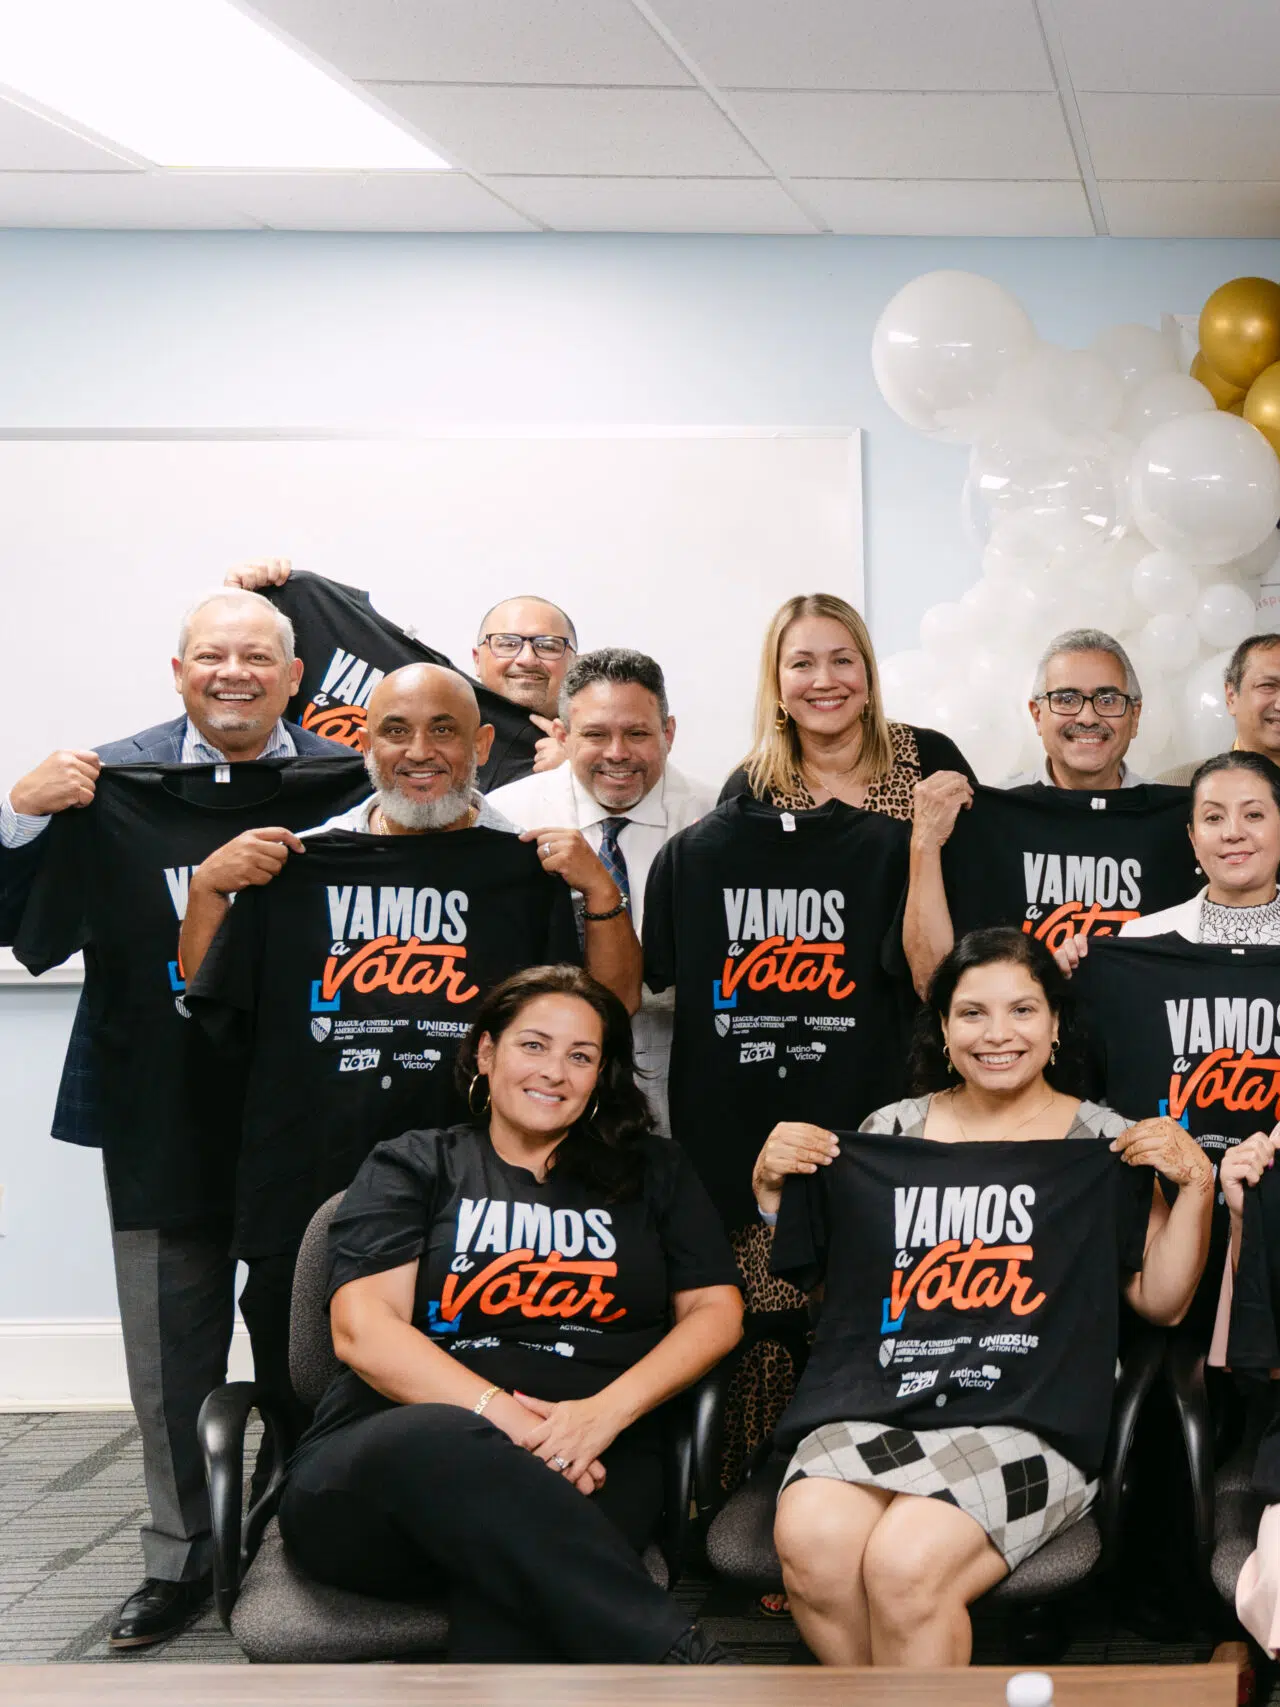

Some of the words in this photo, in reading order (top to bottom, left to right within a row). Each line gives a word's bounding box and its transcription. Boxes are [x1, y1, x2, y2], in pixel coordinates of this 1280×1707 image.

[320, 648, 385, 710] VAM
[313, 693, 330, 707] a
[1023, 852, 1141, 909] VAMOS
[326, 886, 469, 943] VAMOS
[723, 888, 845, 941] VAMOS
[1026, 905, 1043, 919] a
[331, 941, 350, 955] a
[728, 942, 744, 956] a
[787, 1045, 811, 1053] Latino
[393, 1052, 424, 1061] Latino
[794, 1052, 822, 1061] Victory
[402, 1061, 436, 1071] Victory
[1173, 1056, 1191, 1073] a
[895, 1184, 1035, 1249] VAMOS
[455, 1197, 616, 1259] VAMOS
[451, 1254, 475, 1272] a
[895, 1250, 914, 1268] a
[950, 1367, 981, 1379] Latino
[959, 1377, 995, 1390] Victory
